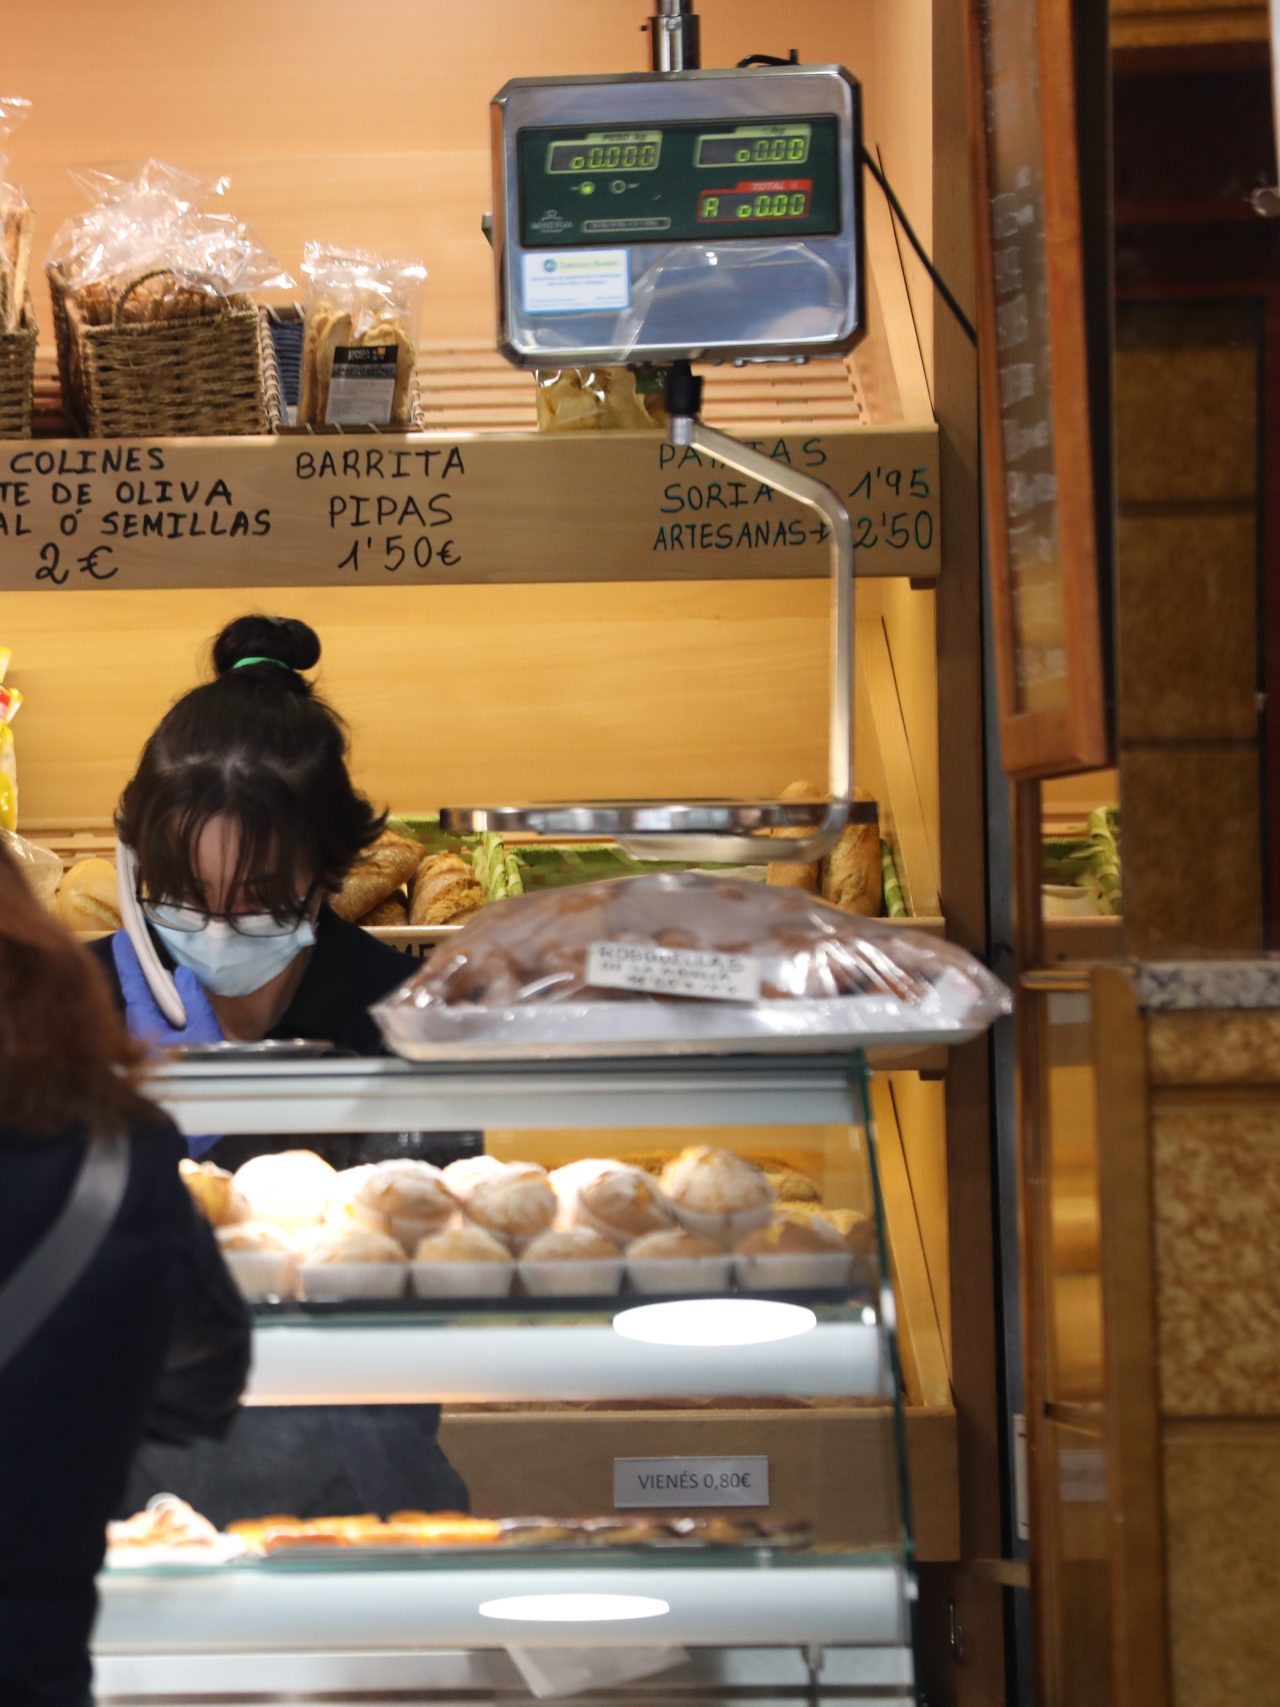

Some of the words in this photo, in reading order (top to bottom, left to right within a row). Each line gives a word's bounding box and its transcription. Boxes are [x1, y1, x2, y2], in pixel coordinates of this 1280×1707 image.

[10, 446, 165, 475] COLINES
[296, 446, 465, 479] BARRITA
[52, 483, 92, 505] DE
[115, 479, 232, 506] OLIVA
[661, 481, 774, 513] SORIA
[848, 466, 930, 500] 1'95
[101, 509, 271, 540] SEMILLAS
[328, 493, 453, 528] PIPAS
[653, 520, 807, 550] ARTESANAS
[853, 510, 933, 550] 2'50
[638, 1470, 698, 1490] VIENÉS
[703, 1472, 752, 1491] 0,80€
